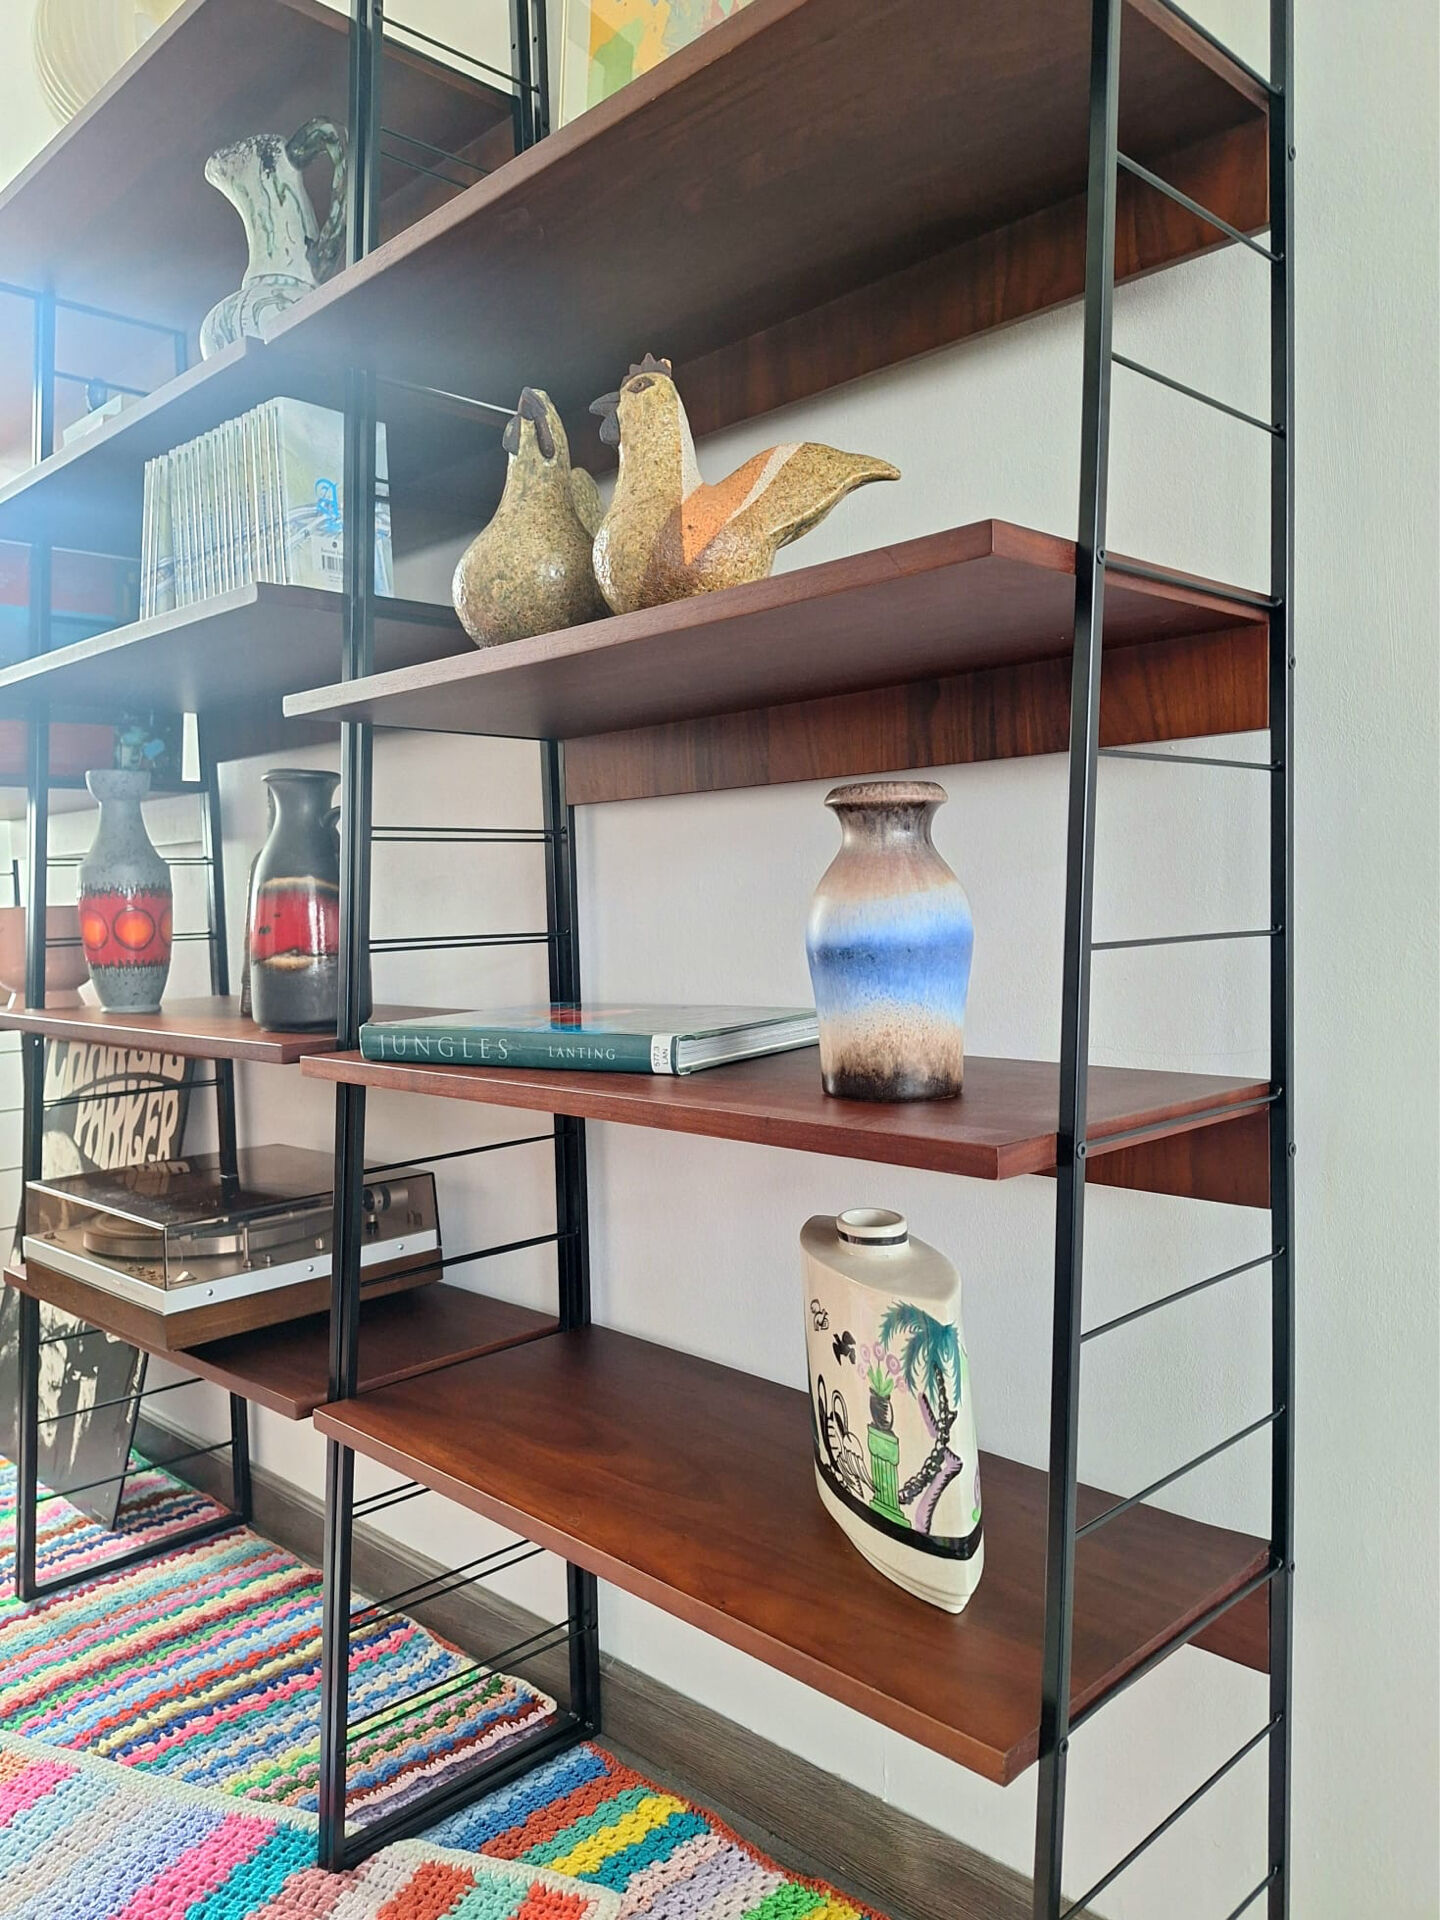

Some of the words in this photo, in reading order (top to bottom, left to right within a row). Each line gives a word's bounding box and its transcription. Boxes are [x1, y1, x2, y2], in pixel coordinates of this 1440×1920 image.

[380, 1034, 508, 1060] JUNGLES
[549, 1045, 616, 1061] LANTING
[73, 1079, 179, 1169] PARKER
